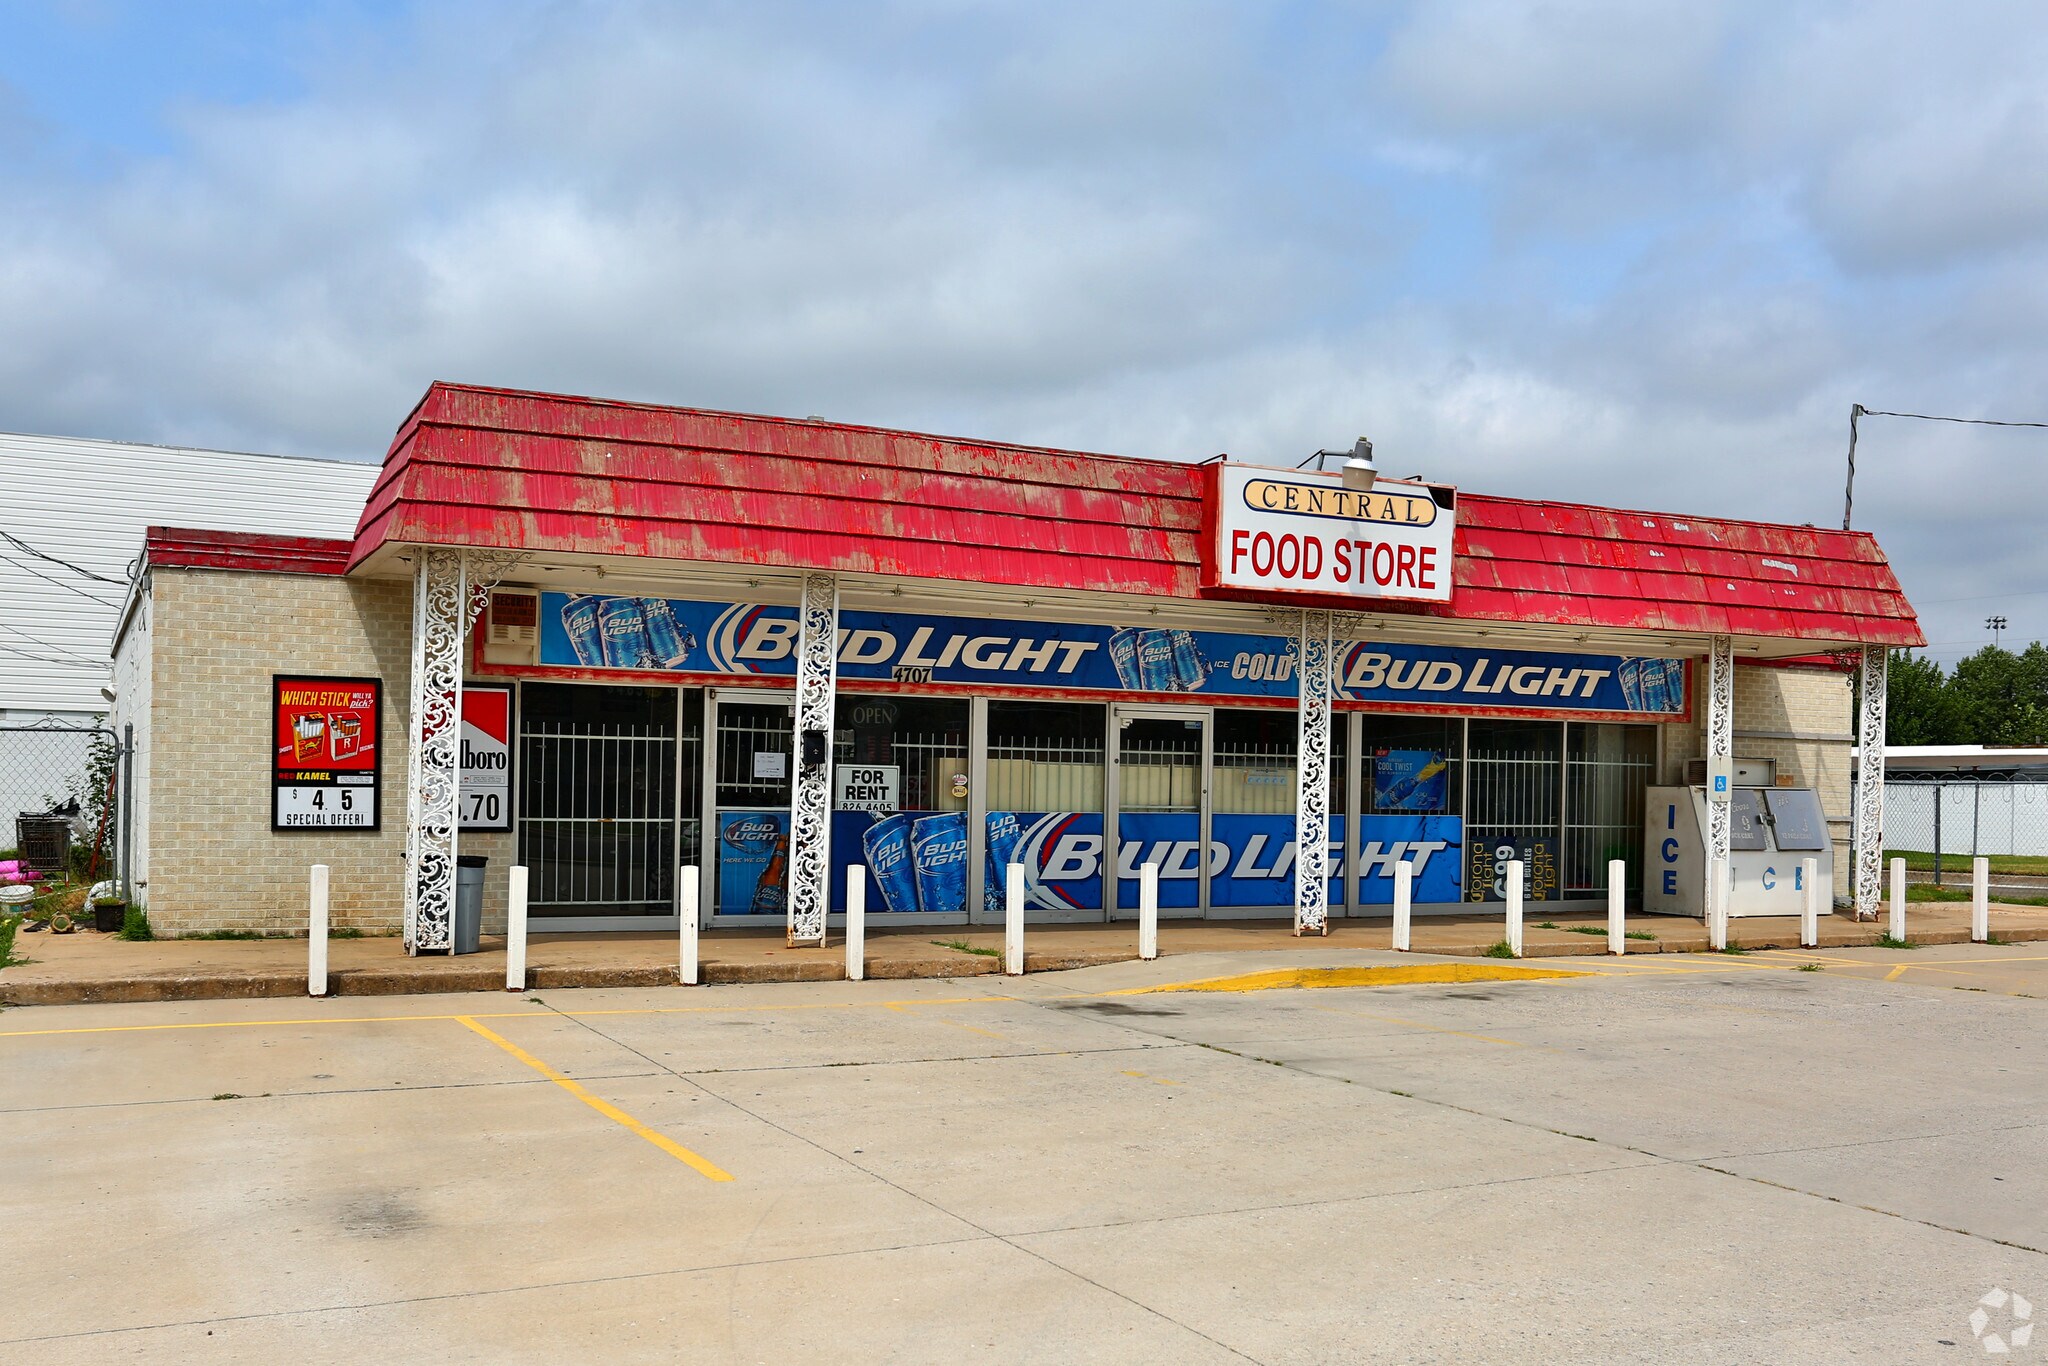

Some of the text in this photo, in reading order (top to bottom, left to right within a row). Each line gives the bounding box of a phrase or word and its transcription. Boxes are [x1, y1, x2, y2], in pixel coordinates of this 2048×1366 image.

[1262, 484, 1419, 522] CENTRAL
[1231, 529, 1437, 590] FOOD STORE
[608, 617, 642, 628] BUD
[897, 626, 1100, 674] LIGHT
[1144, 646, 1171, 656] BUD
[1214, 652, 1294, 682] ICE COLD
[1344, 651, 1611, 698] BUD LIGHT
[893, 667, 932, 684] 4707
[281, 690, 351, 707] WHICH STICK
[853, 706, 893, 724] OPEN
[1377, 762, 1413, 771] COOL TWIST
[296, 772, 331, 780] KAMEL
[851, 769, 884, 785] FOR
[292, 788, 298, 799] $
[845, 785, 890, 801] RENT
[842, 802, 892, 811] 826 4605
[286, 813, 364, 825] SPECIAL OFFER!
[740, 822, 774, 832] BUD
[733, 832, 779, 841] LIGHT
[923, 840, 967, 856] BUD
